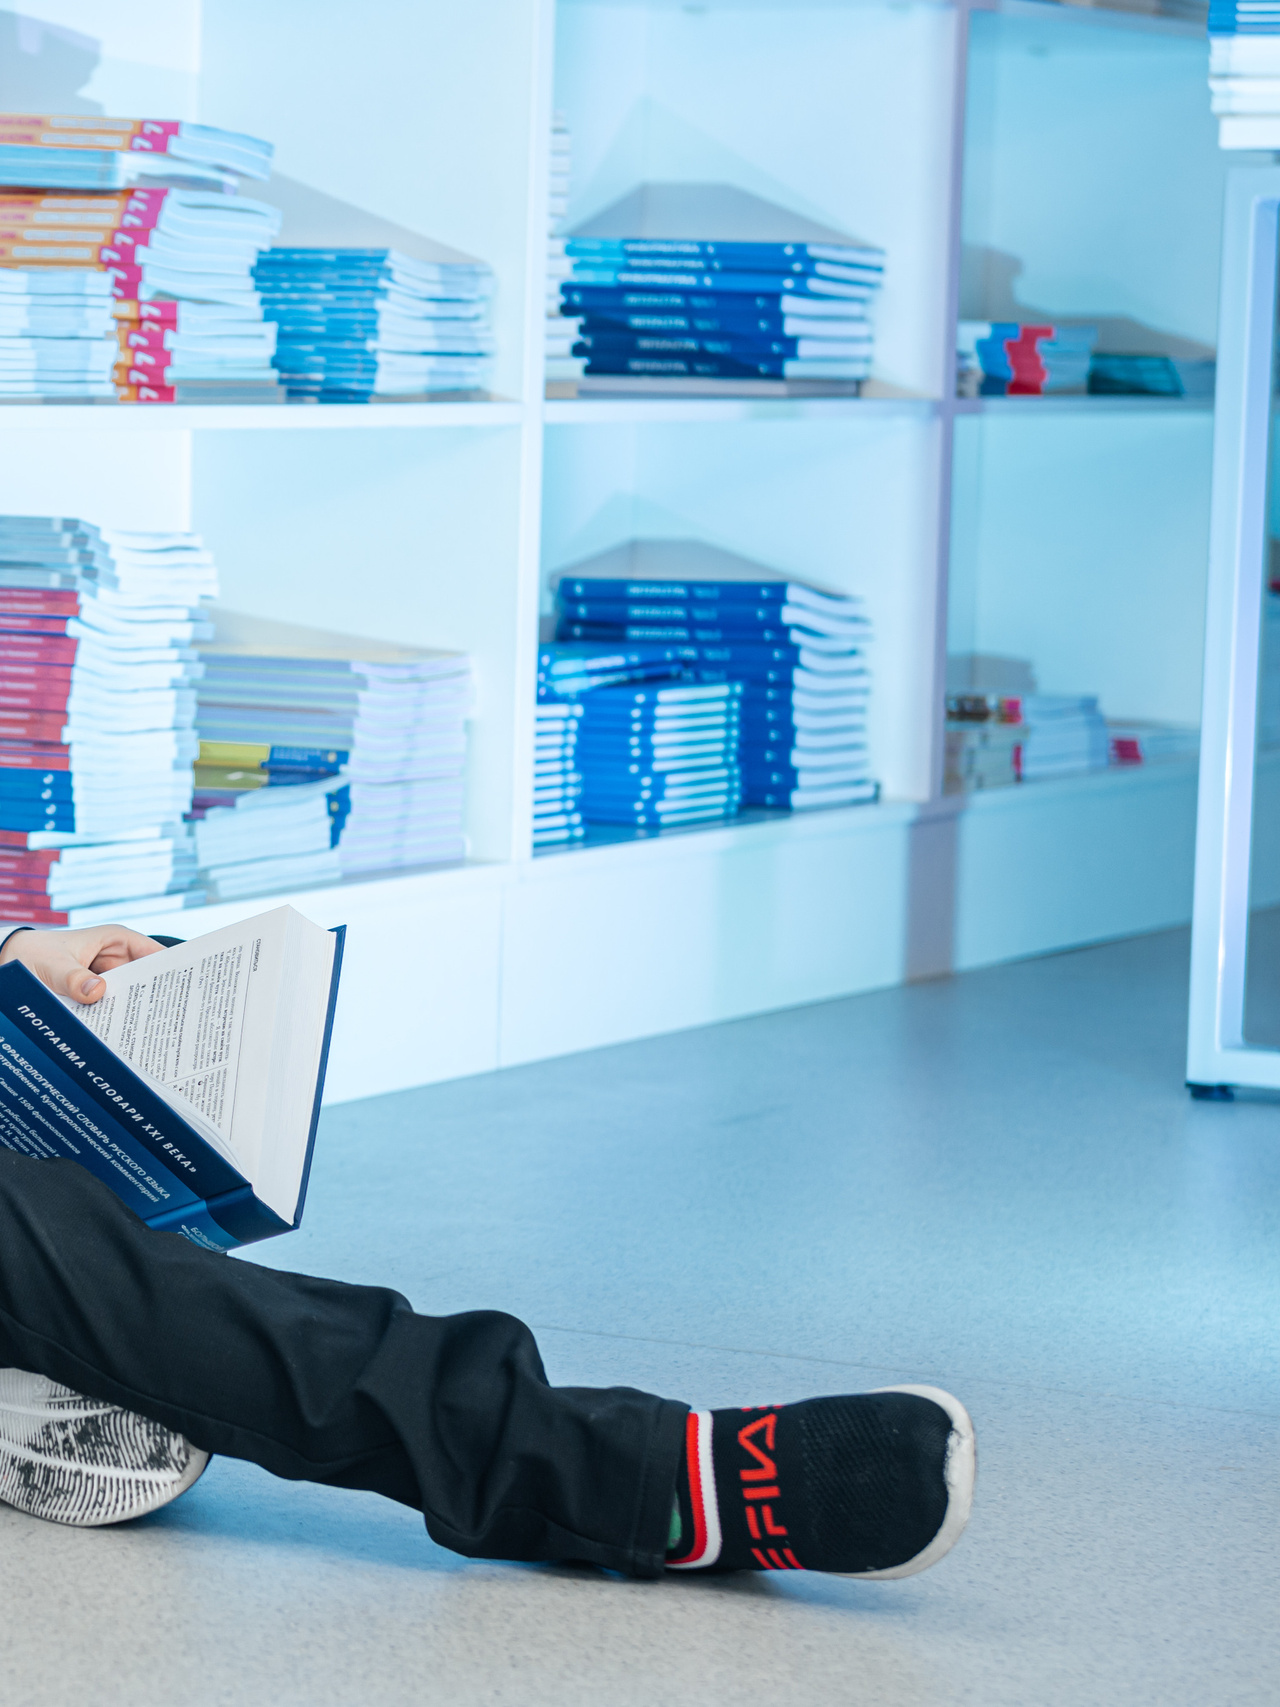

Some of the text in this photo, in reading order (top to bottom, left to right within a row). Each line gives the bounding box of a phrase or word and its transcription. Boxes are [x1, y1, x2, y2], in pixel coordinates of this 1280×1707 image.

[253, 938, 262, 972] СТАНОВИТЬСЯ
[0, 1042, 80, 1114] ФРАЗЕОЛОГИЧЕСКИЙ
[75, 1112, 110, 1144] СЛОВАРЬ
[107, 1142, 146, 1176] РУССКОГО
[142, 1175, 170, 1199] ЯЗЫКА
[16, 1004, 196, 1172] ПРОГРАММА «СЛОВАРИ XXI ВЕКА»
[17, 1096, 35, 1111] 1500
[31, 1109, 81, 1154] фразеологизмов
[39, 1093, 113, 1160] Культурологический
[109, 1158, 159, 1202] комментарий
[737, 1412, 789, 1541] FILA
